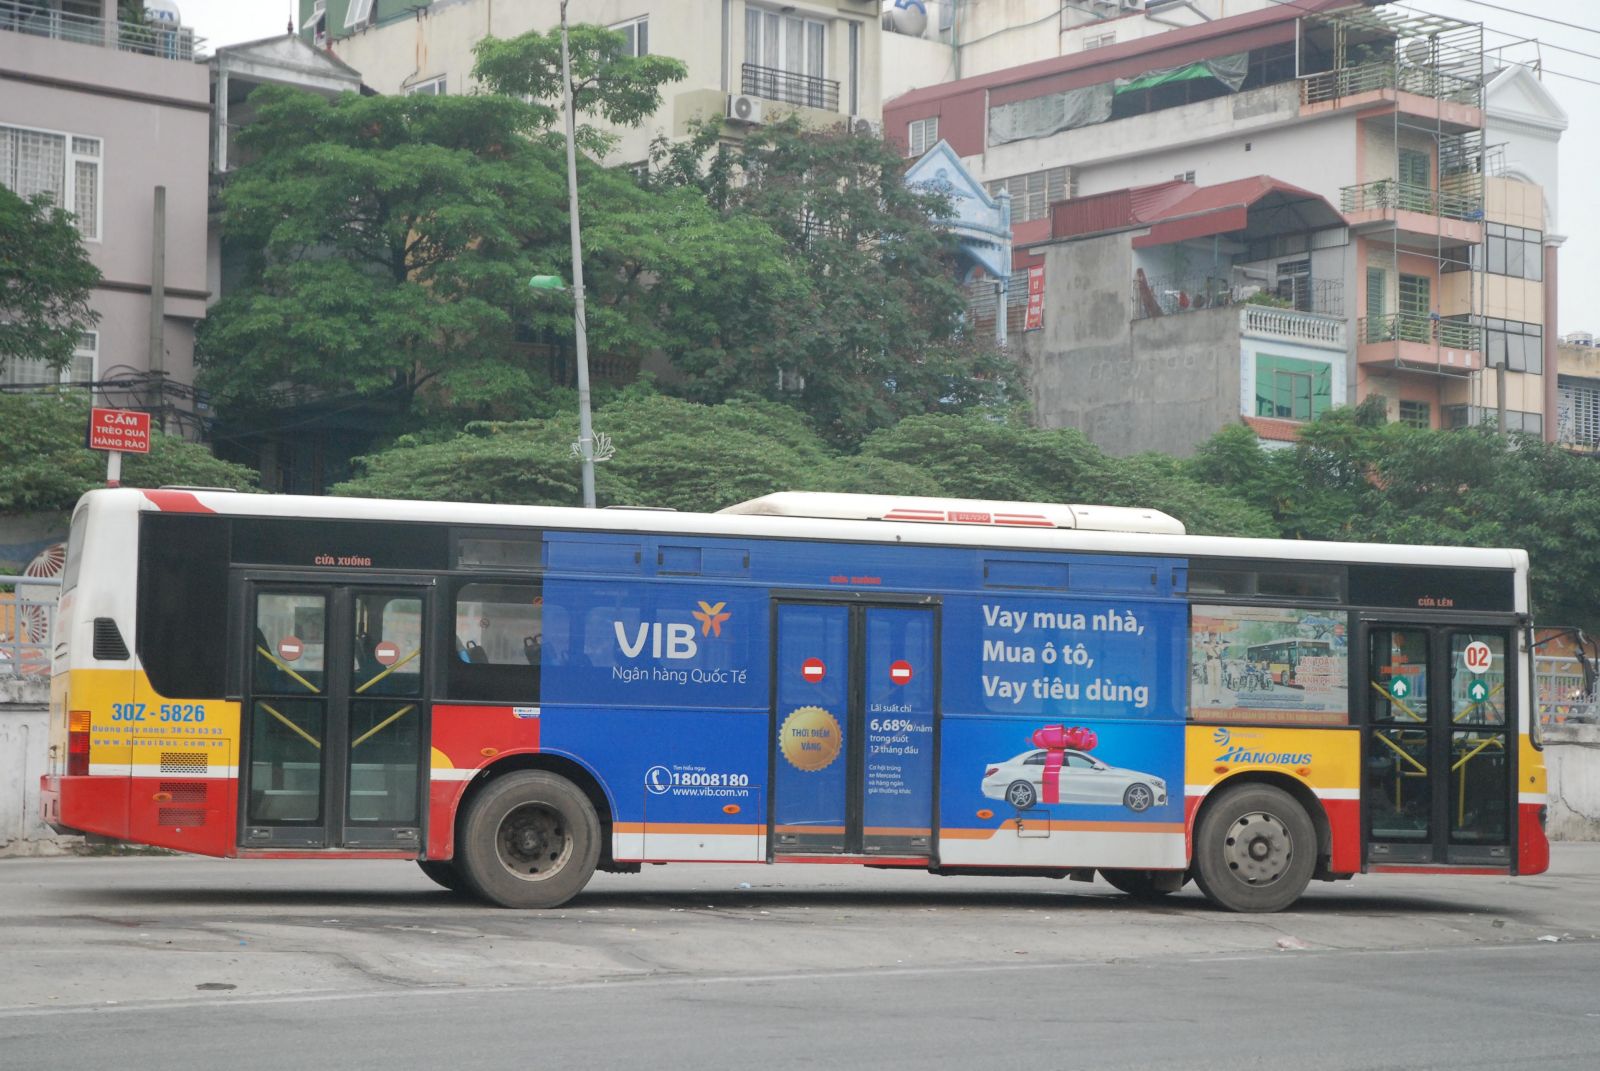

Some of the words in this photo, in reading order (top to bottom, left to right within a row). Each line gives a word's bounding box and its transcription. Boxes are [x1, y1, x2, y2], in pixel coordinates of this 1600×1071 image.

[104, 413, 138, 425] CẤM
[96, 424, 123, 436] TRÈO
[124, 428, 146, 438] QUA
[94, 436, 122, 447] HÀNG
[124, 439, 146, 449] RÀO
[315, 553, 335, 566] CỬA
[337, 554, 372, 566] XUỐNG
[1437, 597, 1454, 607] LÊN
[982, 604, 1028, 634] Vay
[1033, 612, 1086, 631] mua
[1092, 608, 1145, 636] nhà,
[614, 621, 698, 659] VIB
[982, 640, 1036, 664] Mua
[1041, 641, 1057, 664] ô
[1063, 643, 1094, 669] tô,
[1466, 646, 1489, 667] 02
[612, 666, 649, 683] Ngân
[653, 667, 688, 685] hàng
[691, 667, 728, 684] Quốc
[730, 668, 748, 684] Tế
[982, 675, 1027, 704] Vay
[1032, 676, 1080, 700] tiêu
[1086, 678, 1149, 708] dùng
[160, 704, 205, 722] 5826
[673, 773, 749, 786] 18008180
[673, 787, 749, 797] www.vib.com.vn
